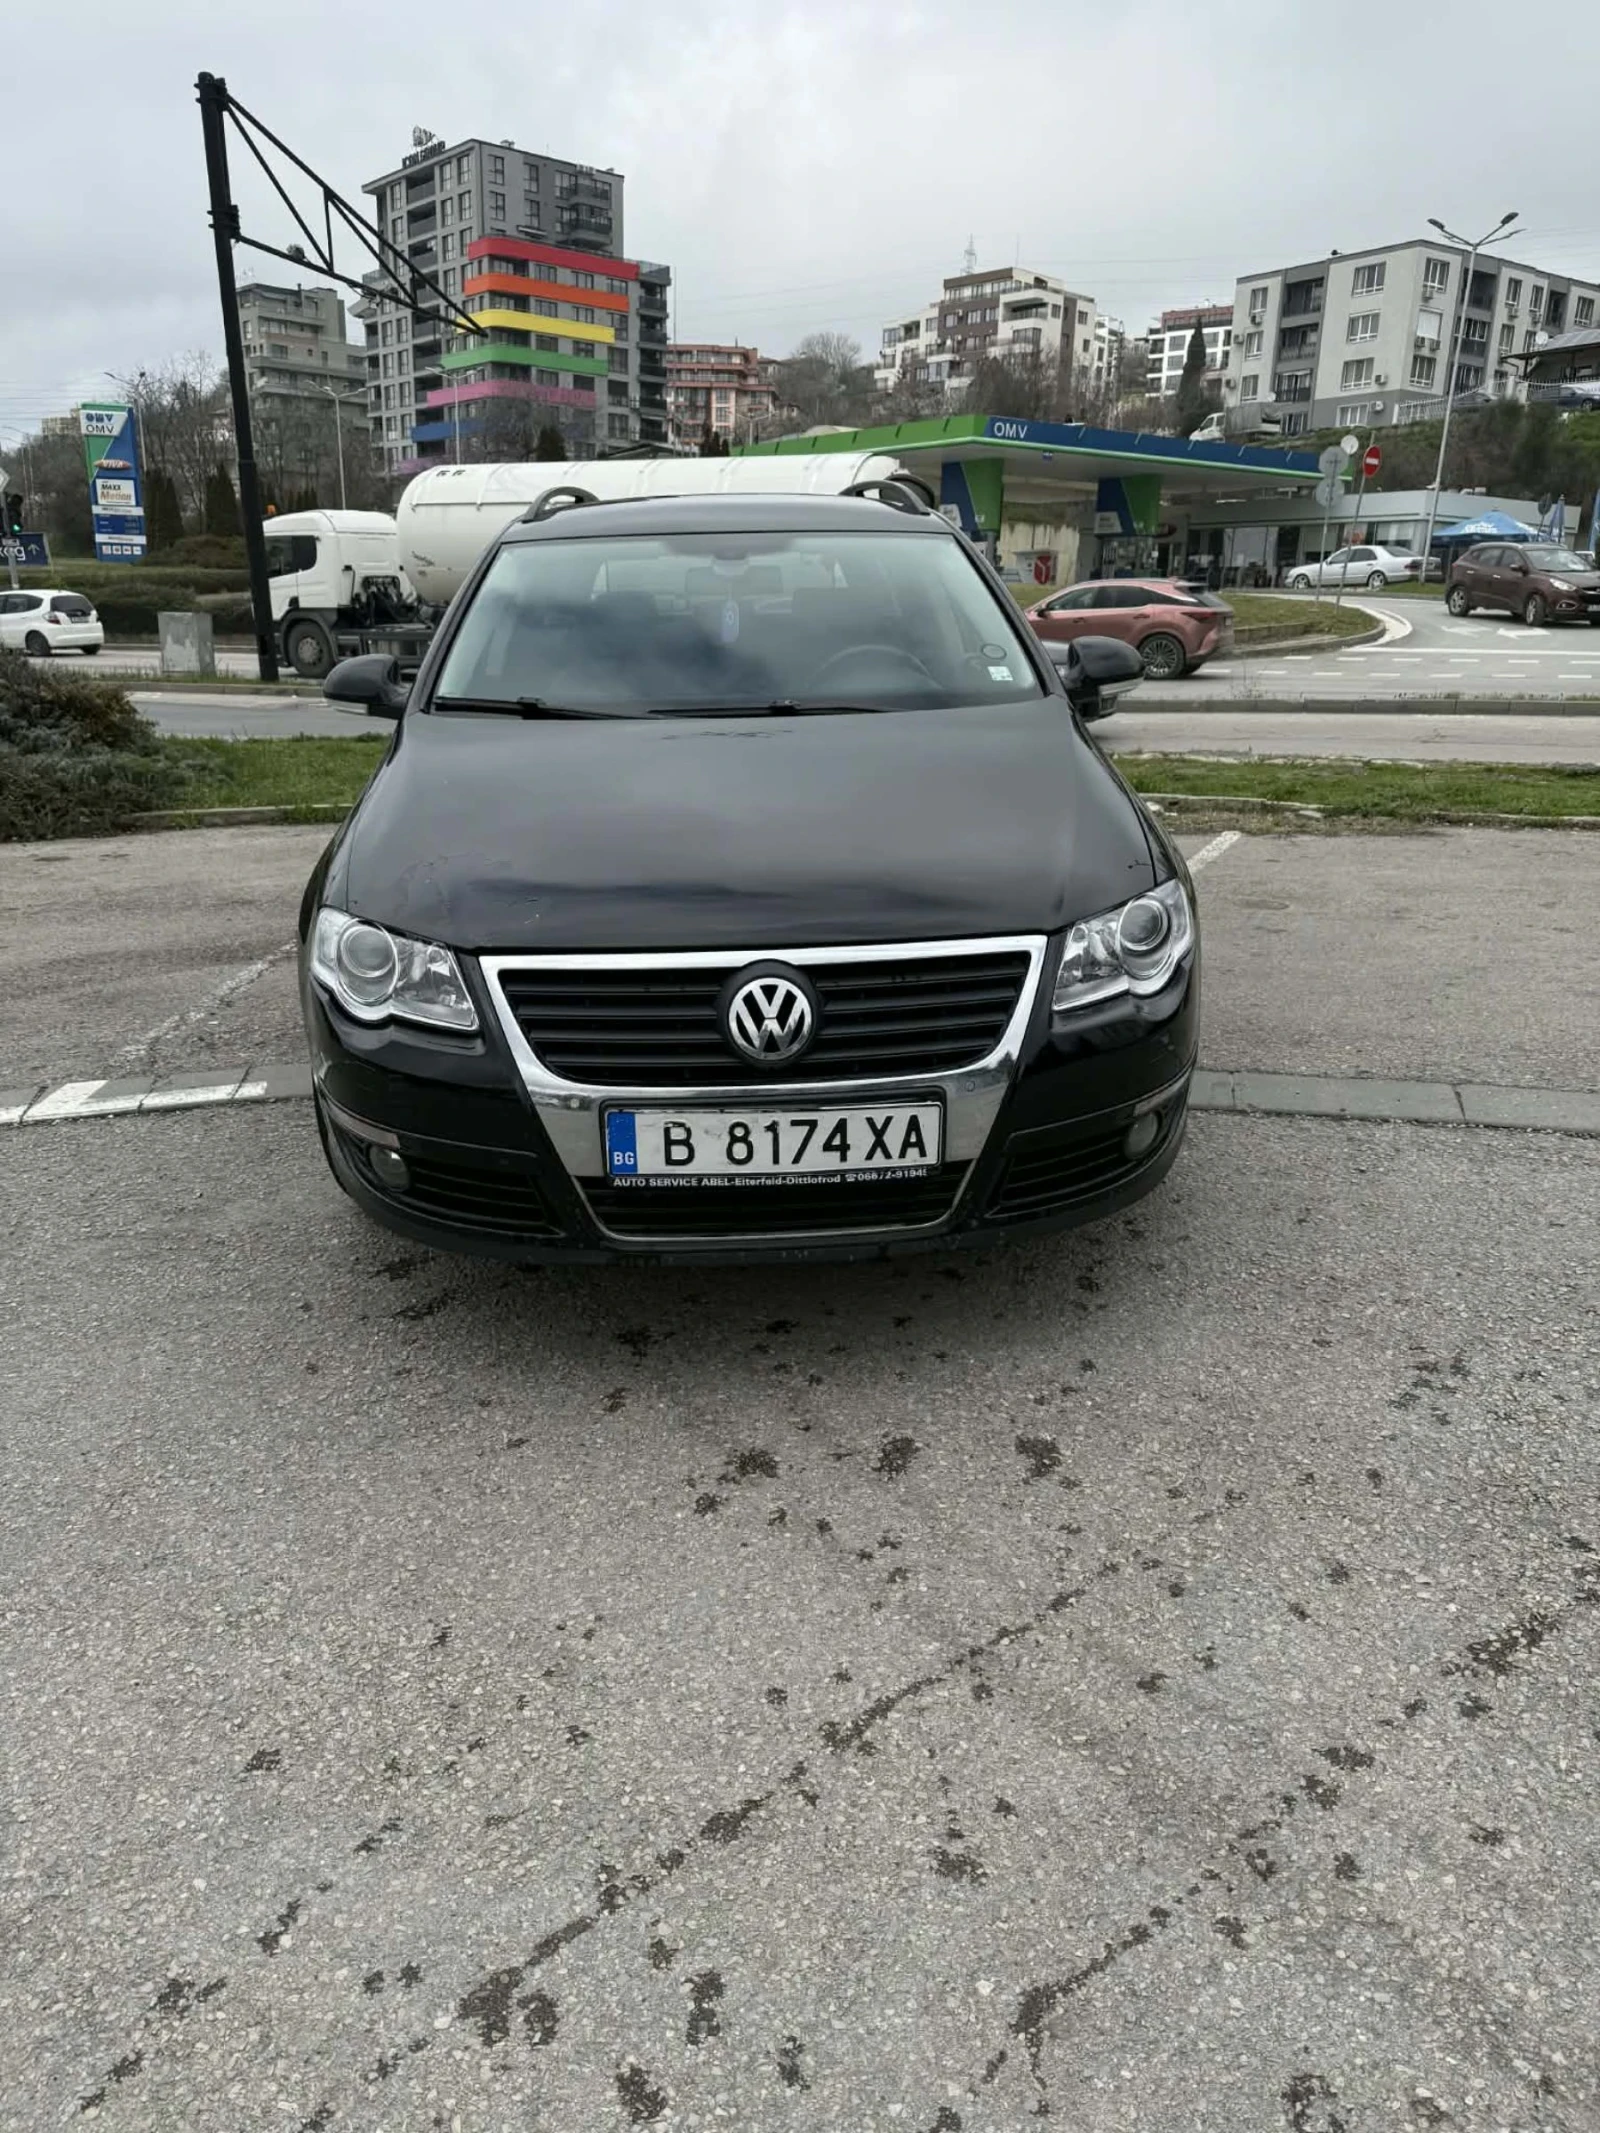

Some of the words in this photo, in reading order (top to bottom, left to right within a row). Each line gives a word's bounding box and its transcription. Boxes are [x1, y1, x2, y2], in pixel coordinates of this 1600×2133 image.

[86, 424, 115, 434] OMV
[994, 422, 1028, 438] OMV
[664, 1121, 695, 1166] B
[726, 1117, 851, 1166] 8174
[865, 1114, 928, 1161] XA
[613, 1152, 635, 1165] BG
[613, 1178, 646, 1187] AUTO
[650, 1178, 699, 1187] SERVICE
